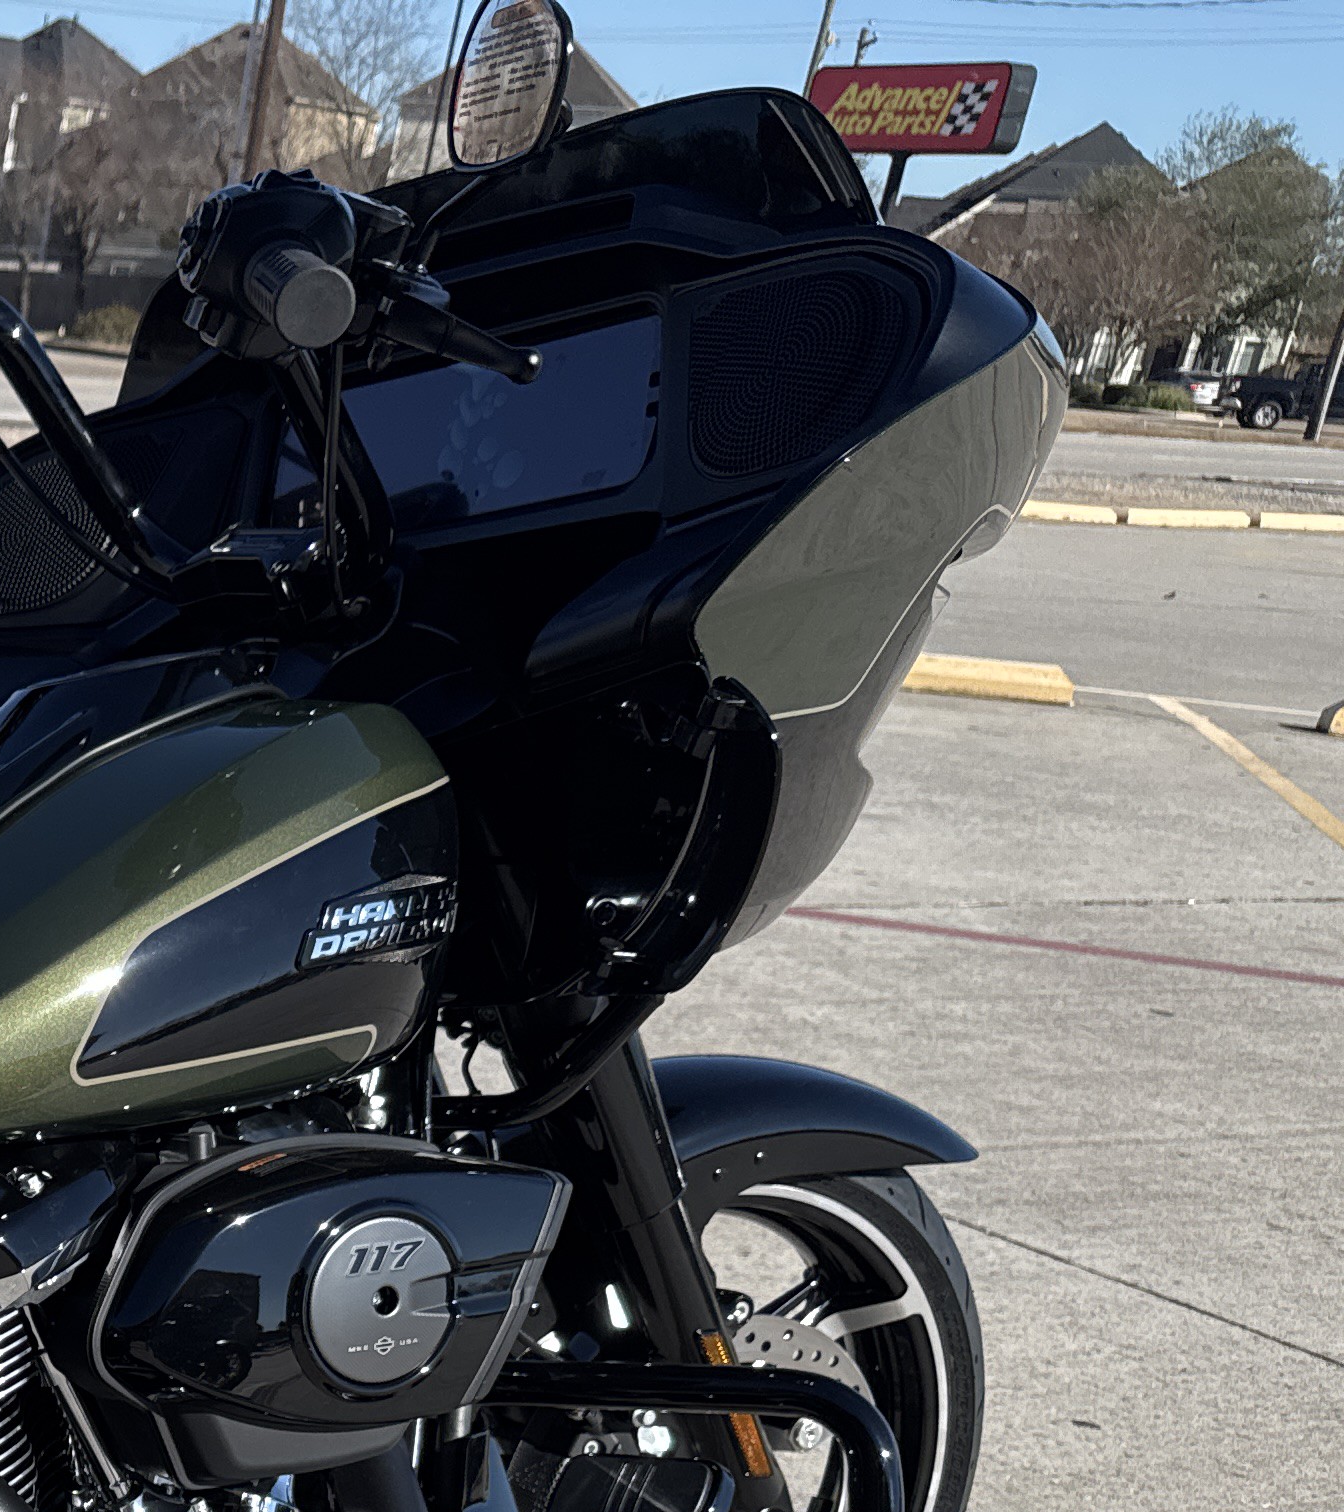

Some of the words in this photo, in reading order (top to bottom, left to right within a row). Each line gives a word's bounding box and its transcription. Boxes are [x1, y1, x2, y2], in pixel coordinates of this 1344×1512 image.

[833, 82, 949, 112] Advance
[869, 109, 937, 136] Parts
[345, 1237, 426, 1277] 117
[399, 1338, 419, 1346] USA
